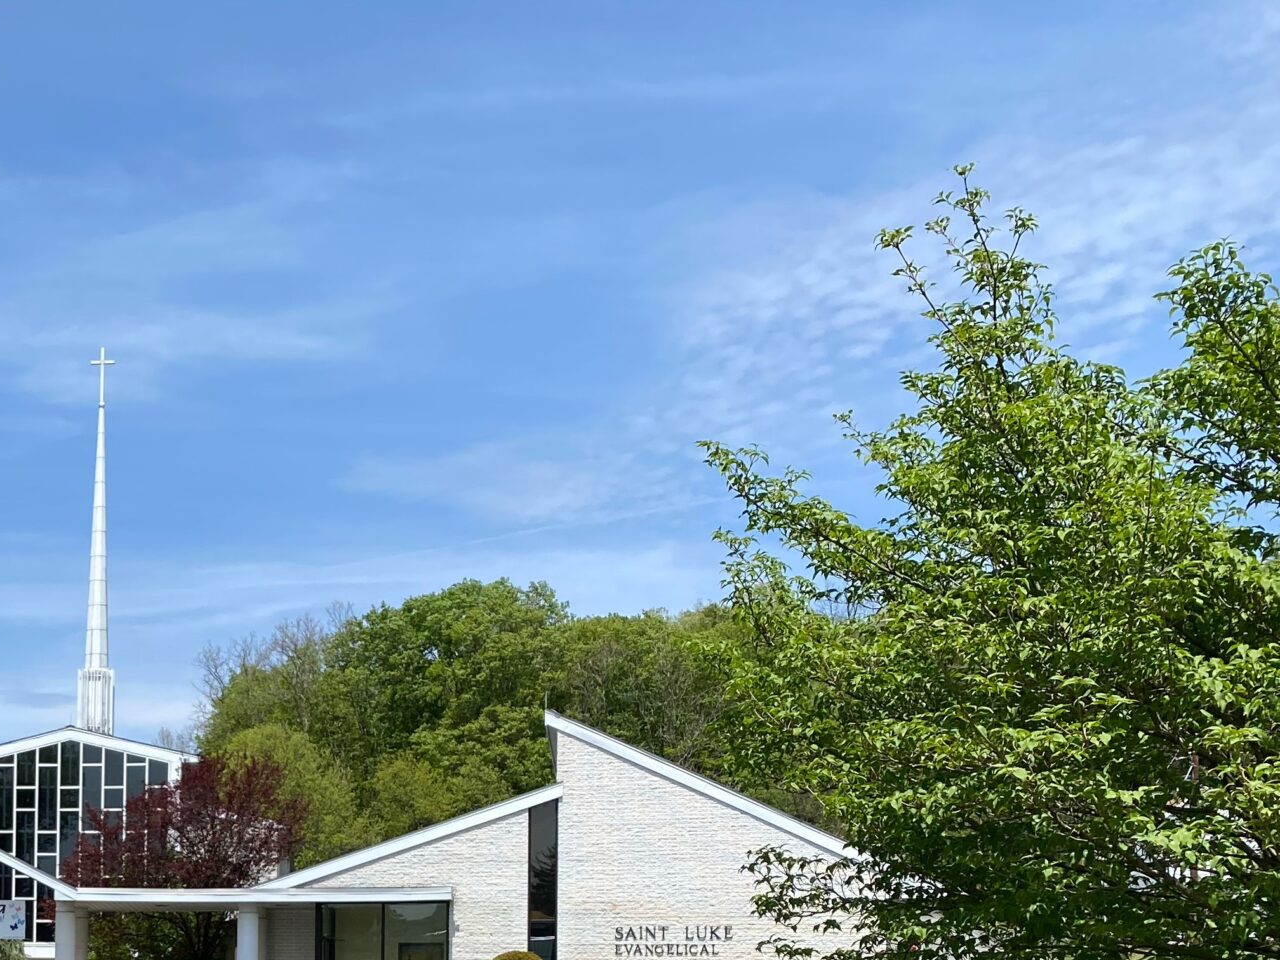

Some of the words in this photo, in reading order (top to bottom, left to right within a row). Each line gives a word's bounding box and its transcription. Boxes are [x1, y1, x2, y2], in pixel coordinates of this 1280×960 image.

[614, 926, 669, 941] SAINT
[684, 926, 734, 942] LUKE
[614, 943, 720, 957] EVANGELICAL
